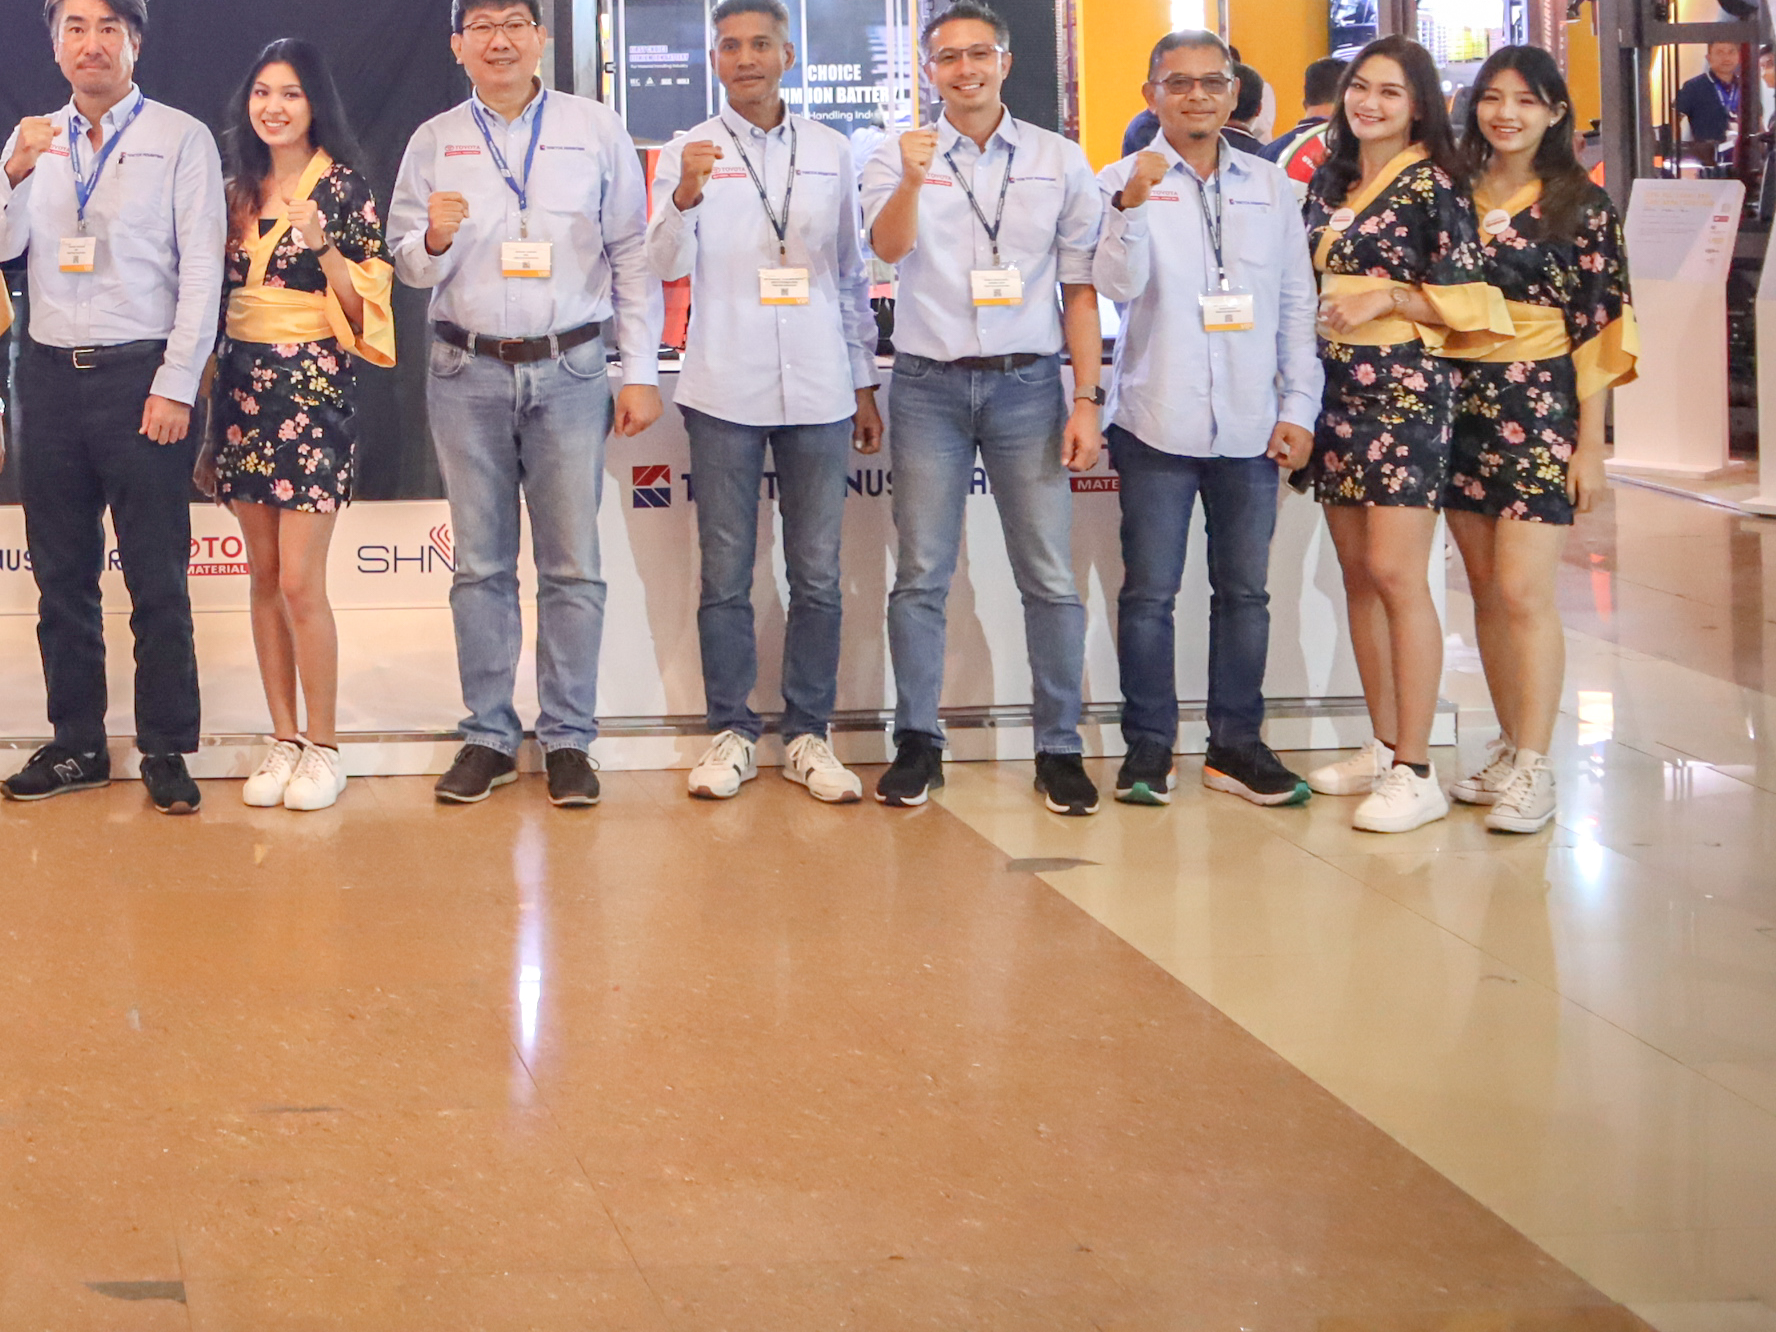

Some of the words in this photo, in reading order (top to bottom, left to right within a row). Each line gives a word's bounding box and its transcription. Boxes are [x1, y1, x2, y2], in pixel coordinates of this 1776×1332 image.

[807, 63, 862, 82] CHOICE
[1077, 479, 1119, 490] MATE
[187, 564, 247, 574] MATERIAL
